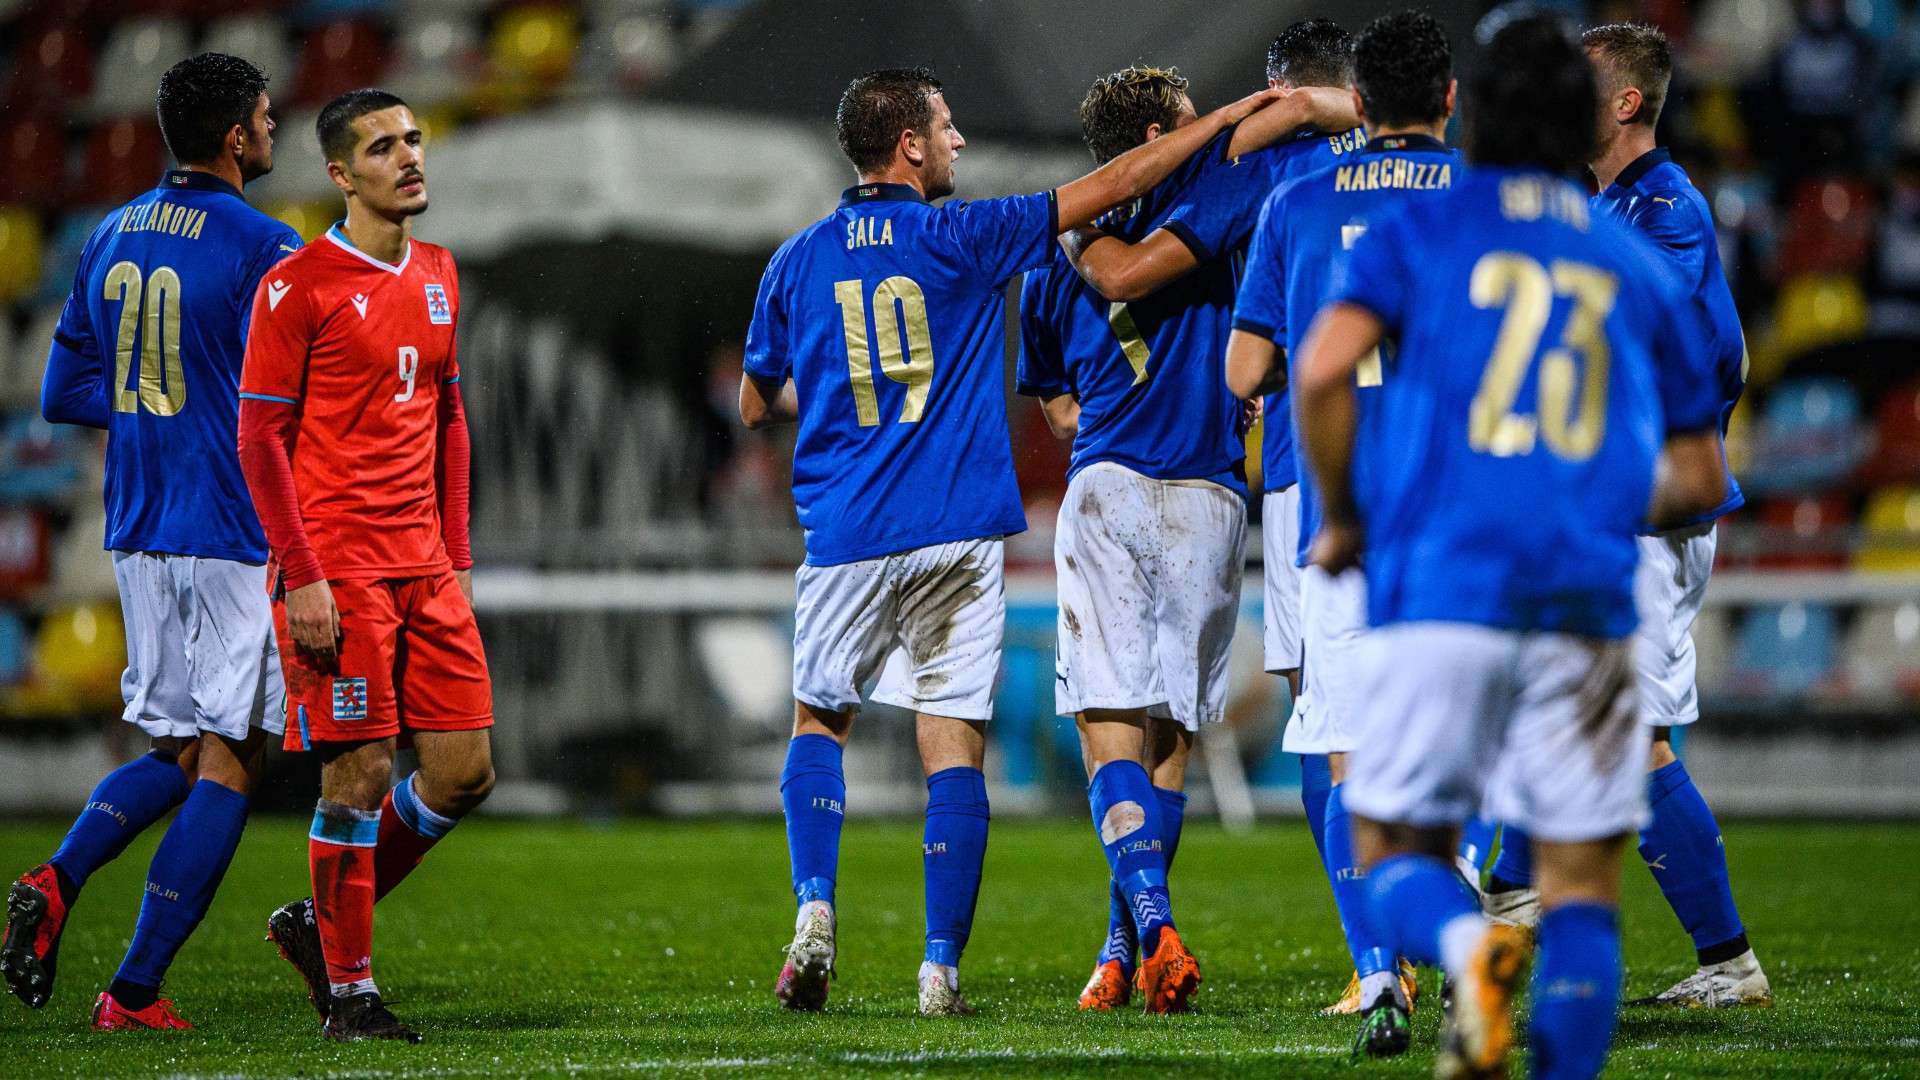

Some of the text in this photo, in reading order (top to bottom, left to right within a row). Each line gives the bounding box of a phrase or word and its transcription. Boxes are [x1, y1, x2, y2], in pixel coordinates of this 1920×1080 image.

[1334, 158, 1451, 192] MARCHIZZA
[118, 201, 208, 240] BELLANOVA
[847, 216, 893, 250] SALA
[104, 260, 187, 417] 20
[834, 275, 934, 428] 19
[1469, 250, 1620, 464] 23
[394, 345, 418, 402] 9
